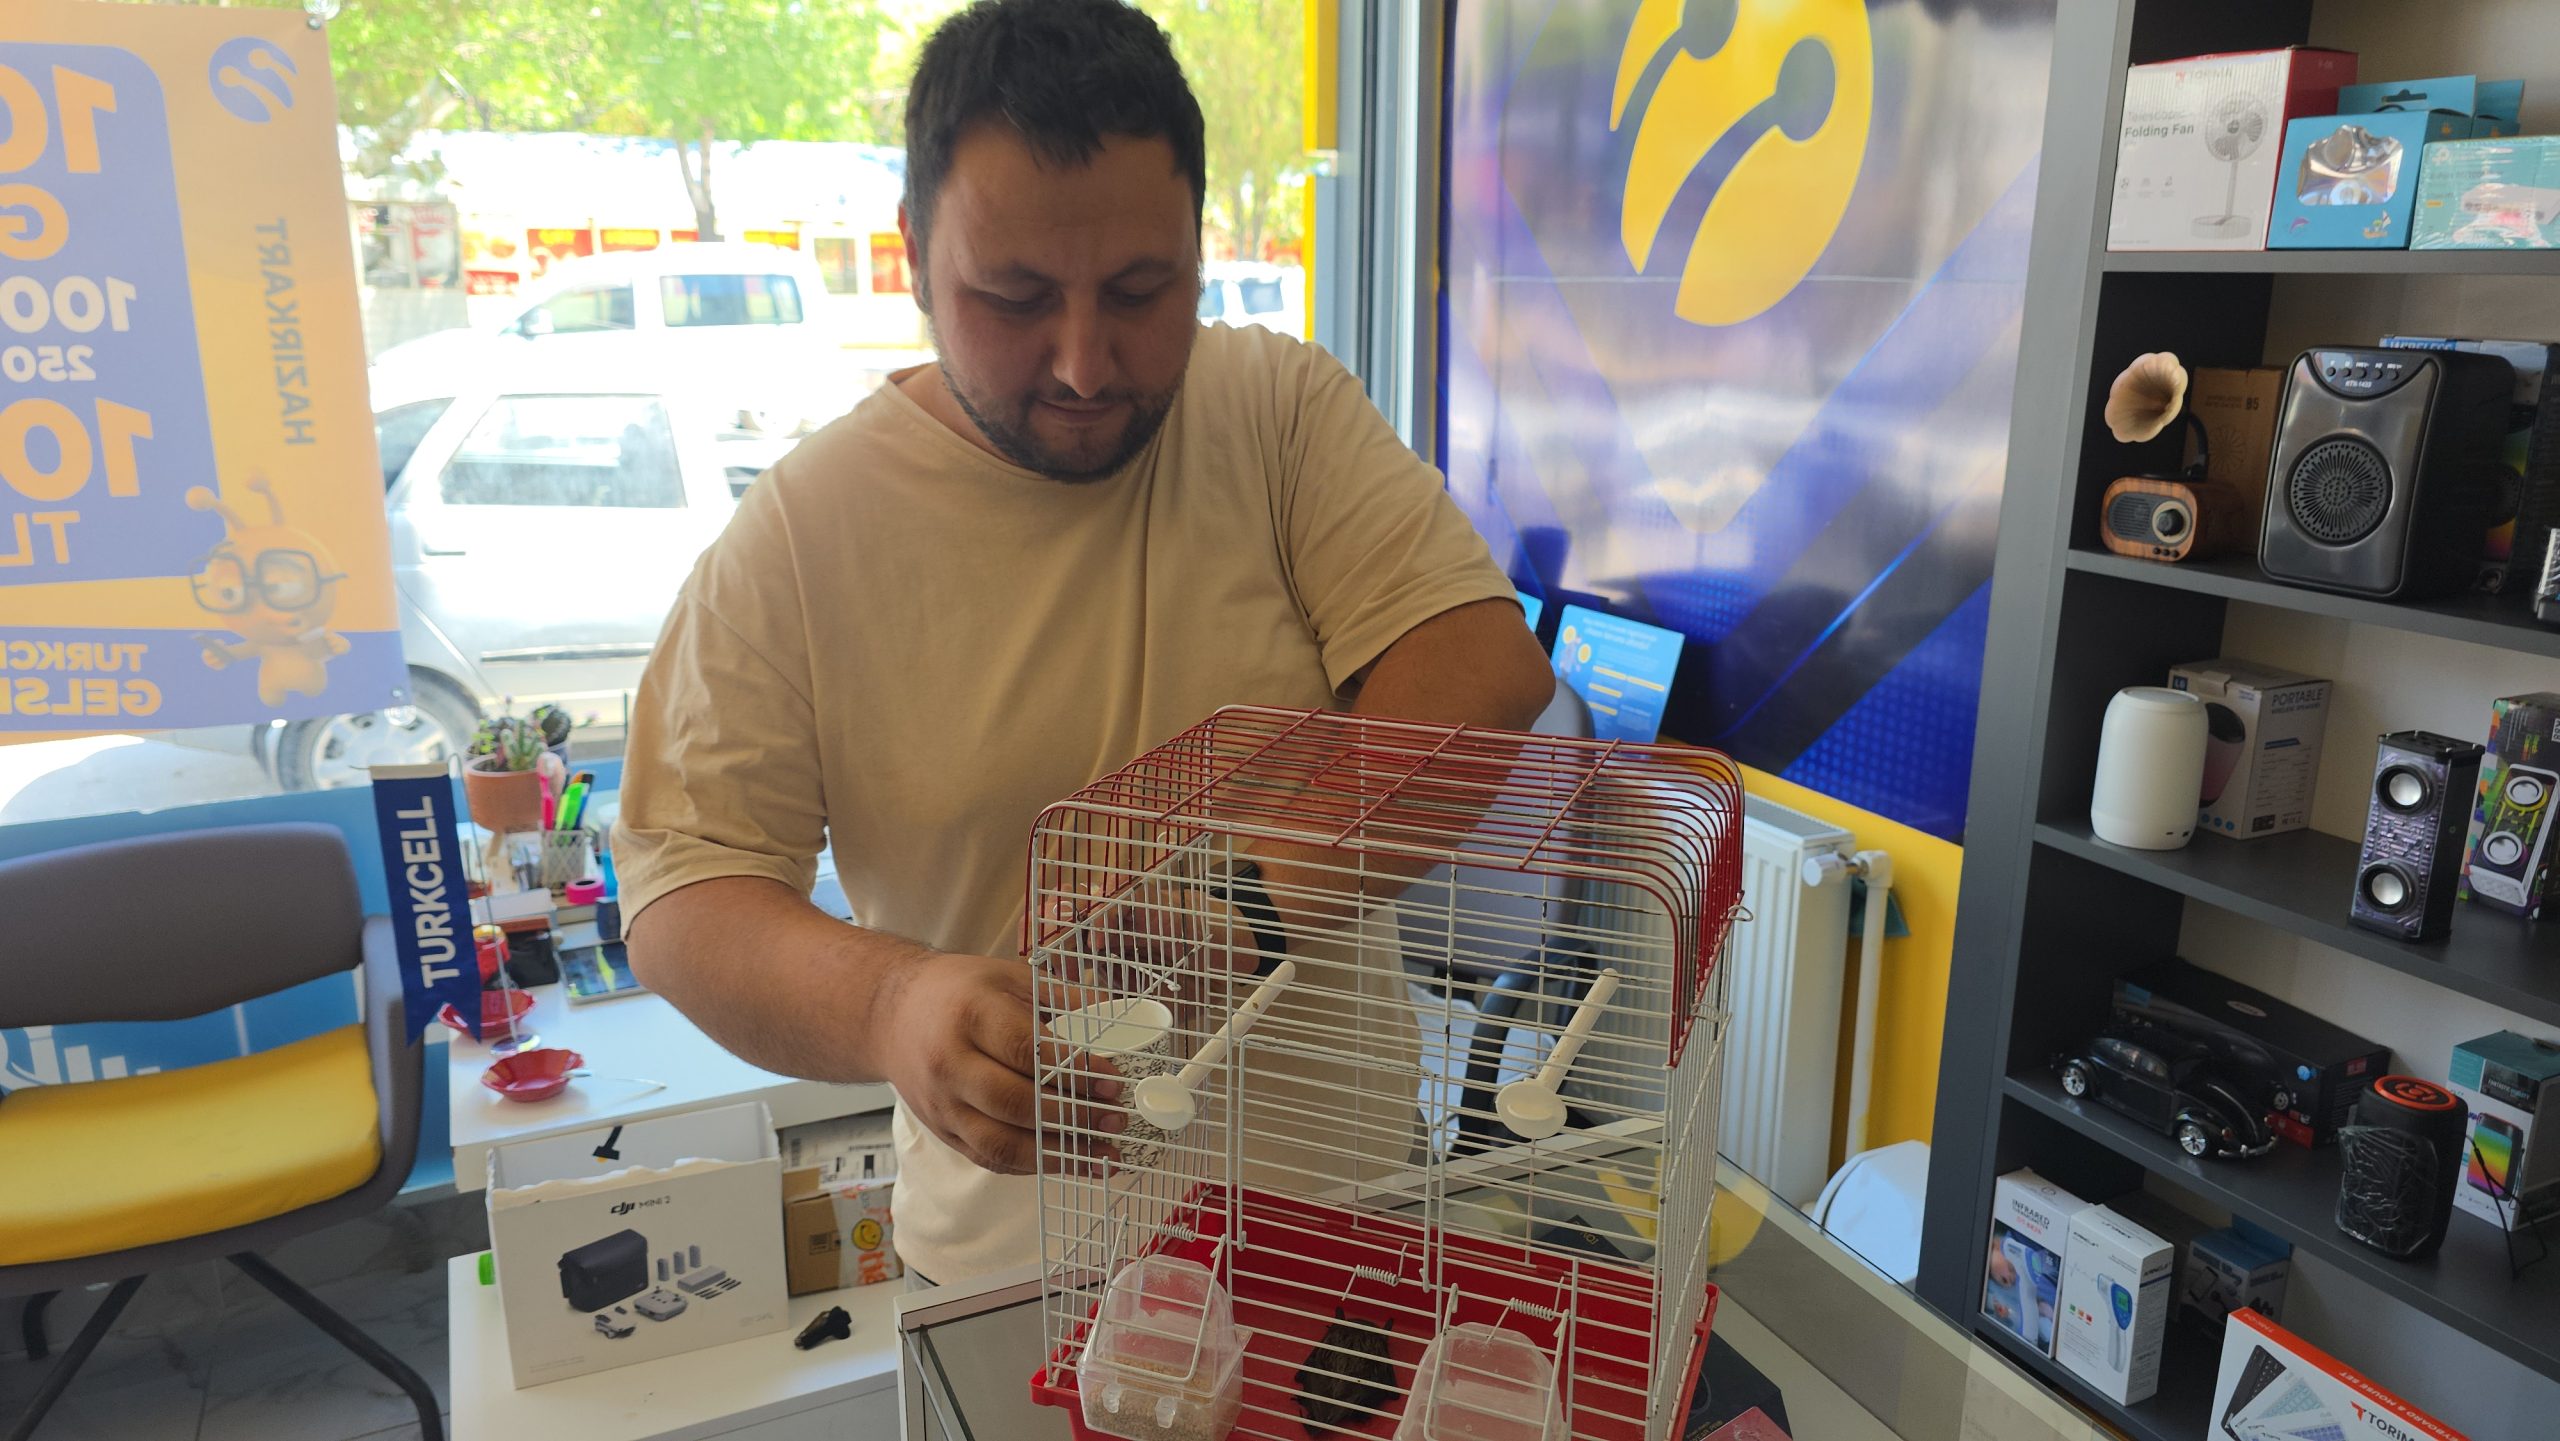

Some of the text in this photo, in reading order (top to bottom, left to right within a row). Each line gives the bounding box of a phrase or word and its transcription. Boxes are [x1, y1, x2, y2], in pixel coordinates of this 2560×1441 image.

[2124, 123, 2195, 139] Folding Fan
[2272, 688, 2324, 707] PORTABLE
[397, 796, 460, 988] TURKCELL
[2012, 1199, 2050, 1226] INFRARED
[2339, 1371, 2360, 1384] SET
[2359, 1383, 2397, 1406] MOUSE
